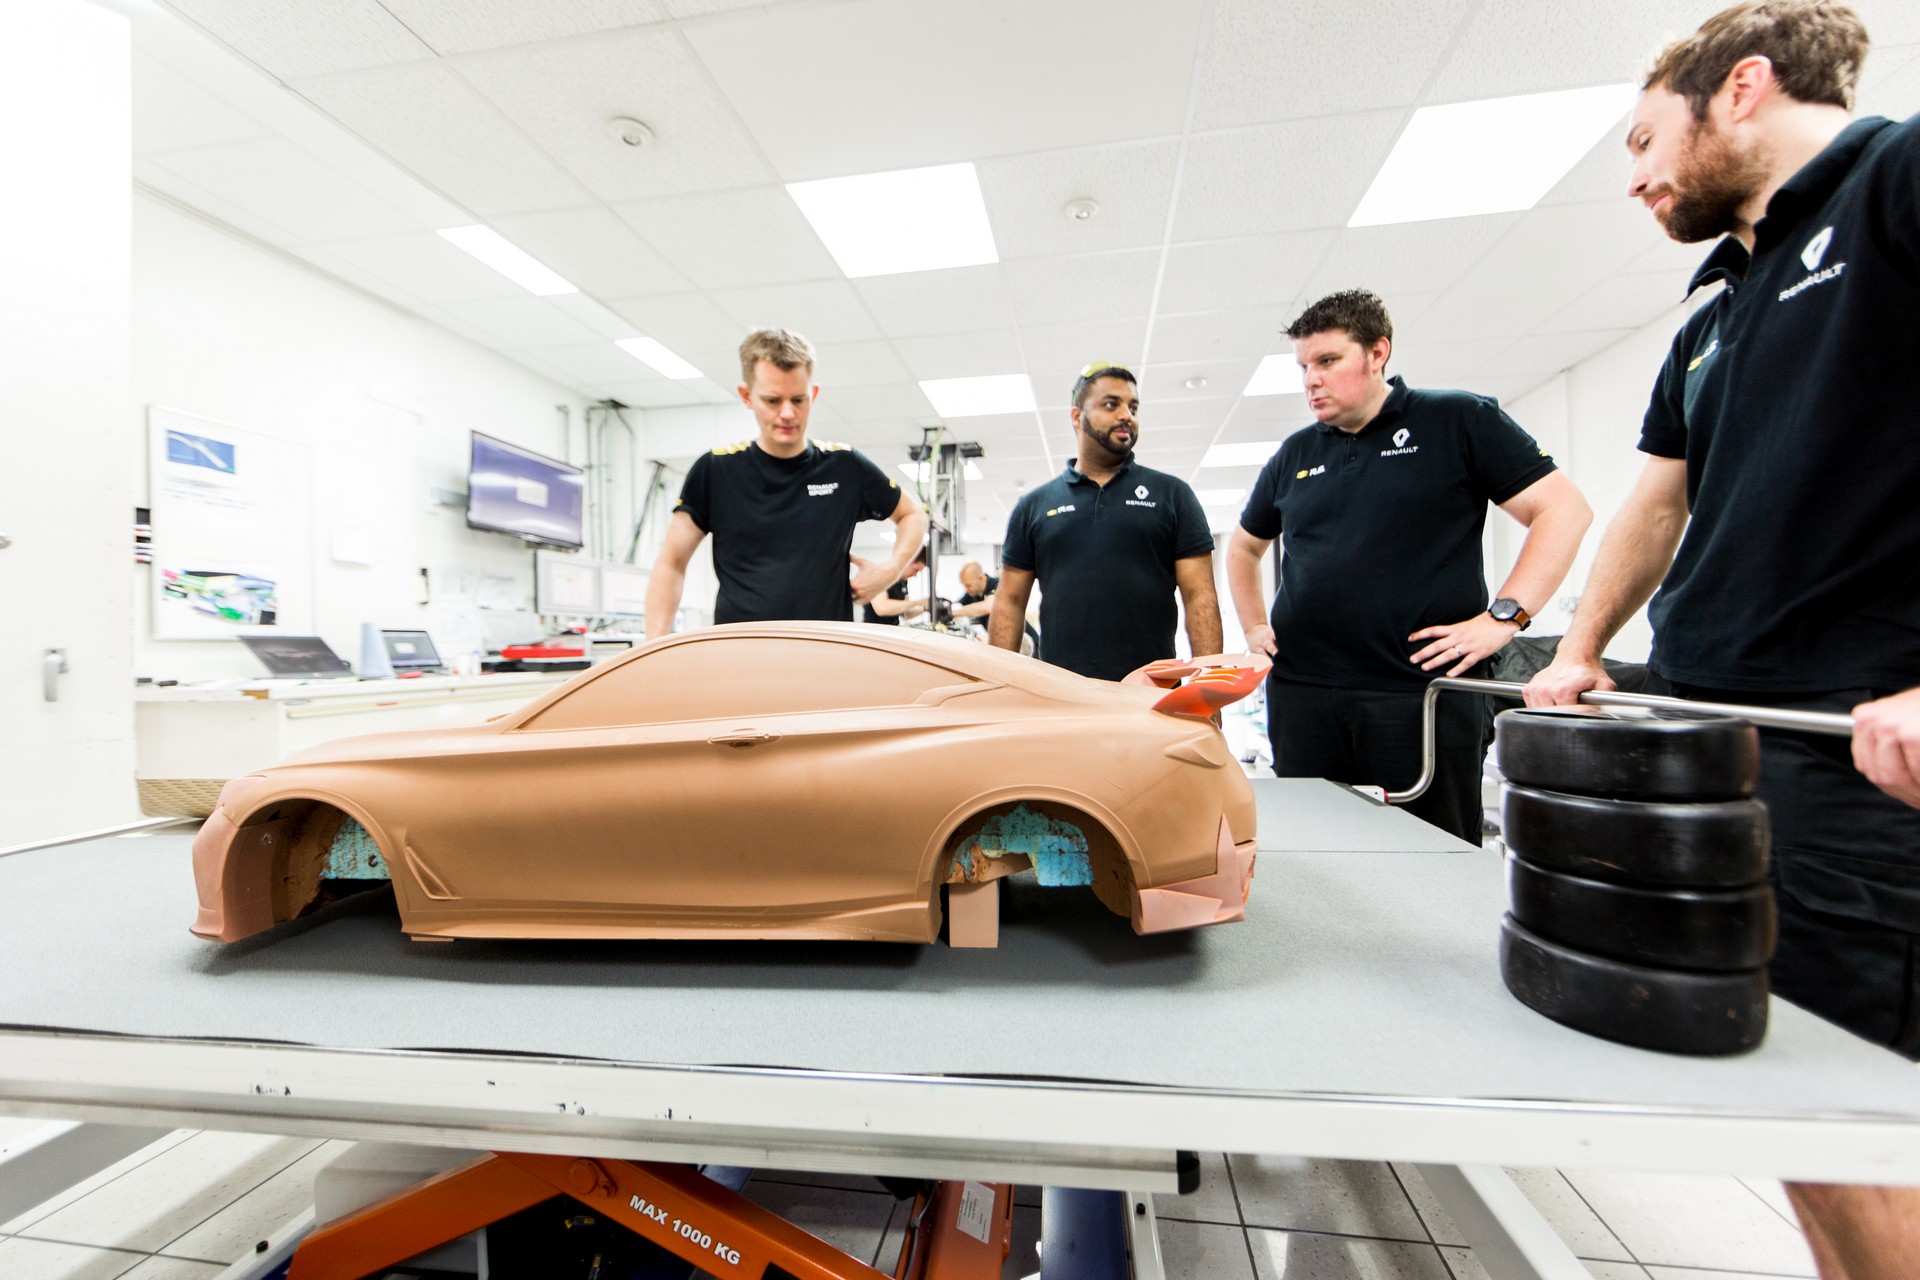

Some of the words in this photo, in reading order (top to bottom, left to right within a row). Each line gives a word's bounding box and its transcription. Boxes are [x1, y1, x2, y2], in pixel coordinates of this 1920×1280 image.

[1380, 446, 1419, 457] RENAULT
[807, 482, 839, 491] RENAULT
[1125, 500, 1156, 508] RENAULT
[629, 1194, 669, 1226] MAX
[672, 1219, 712, 1250] 1000
[714, 1242, 741, 1265] KG
